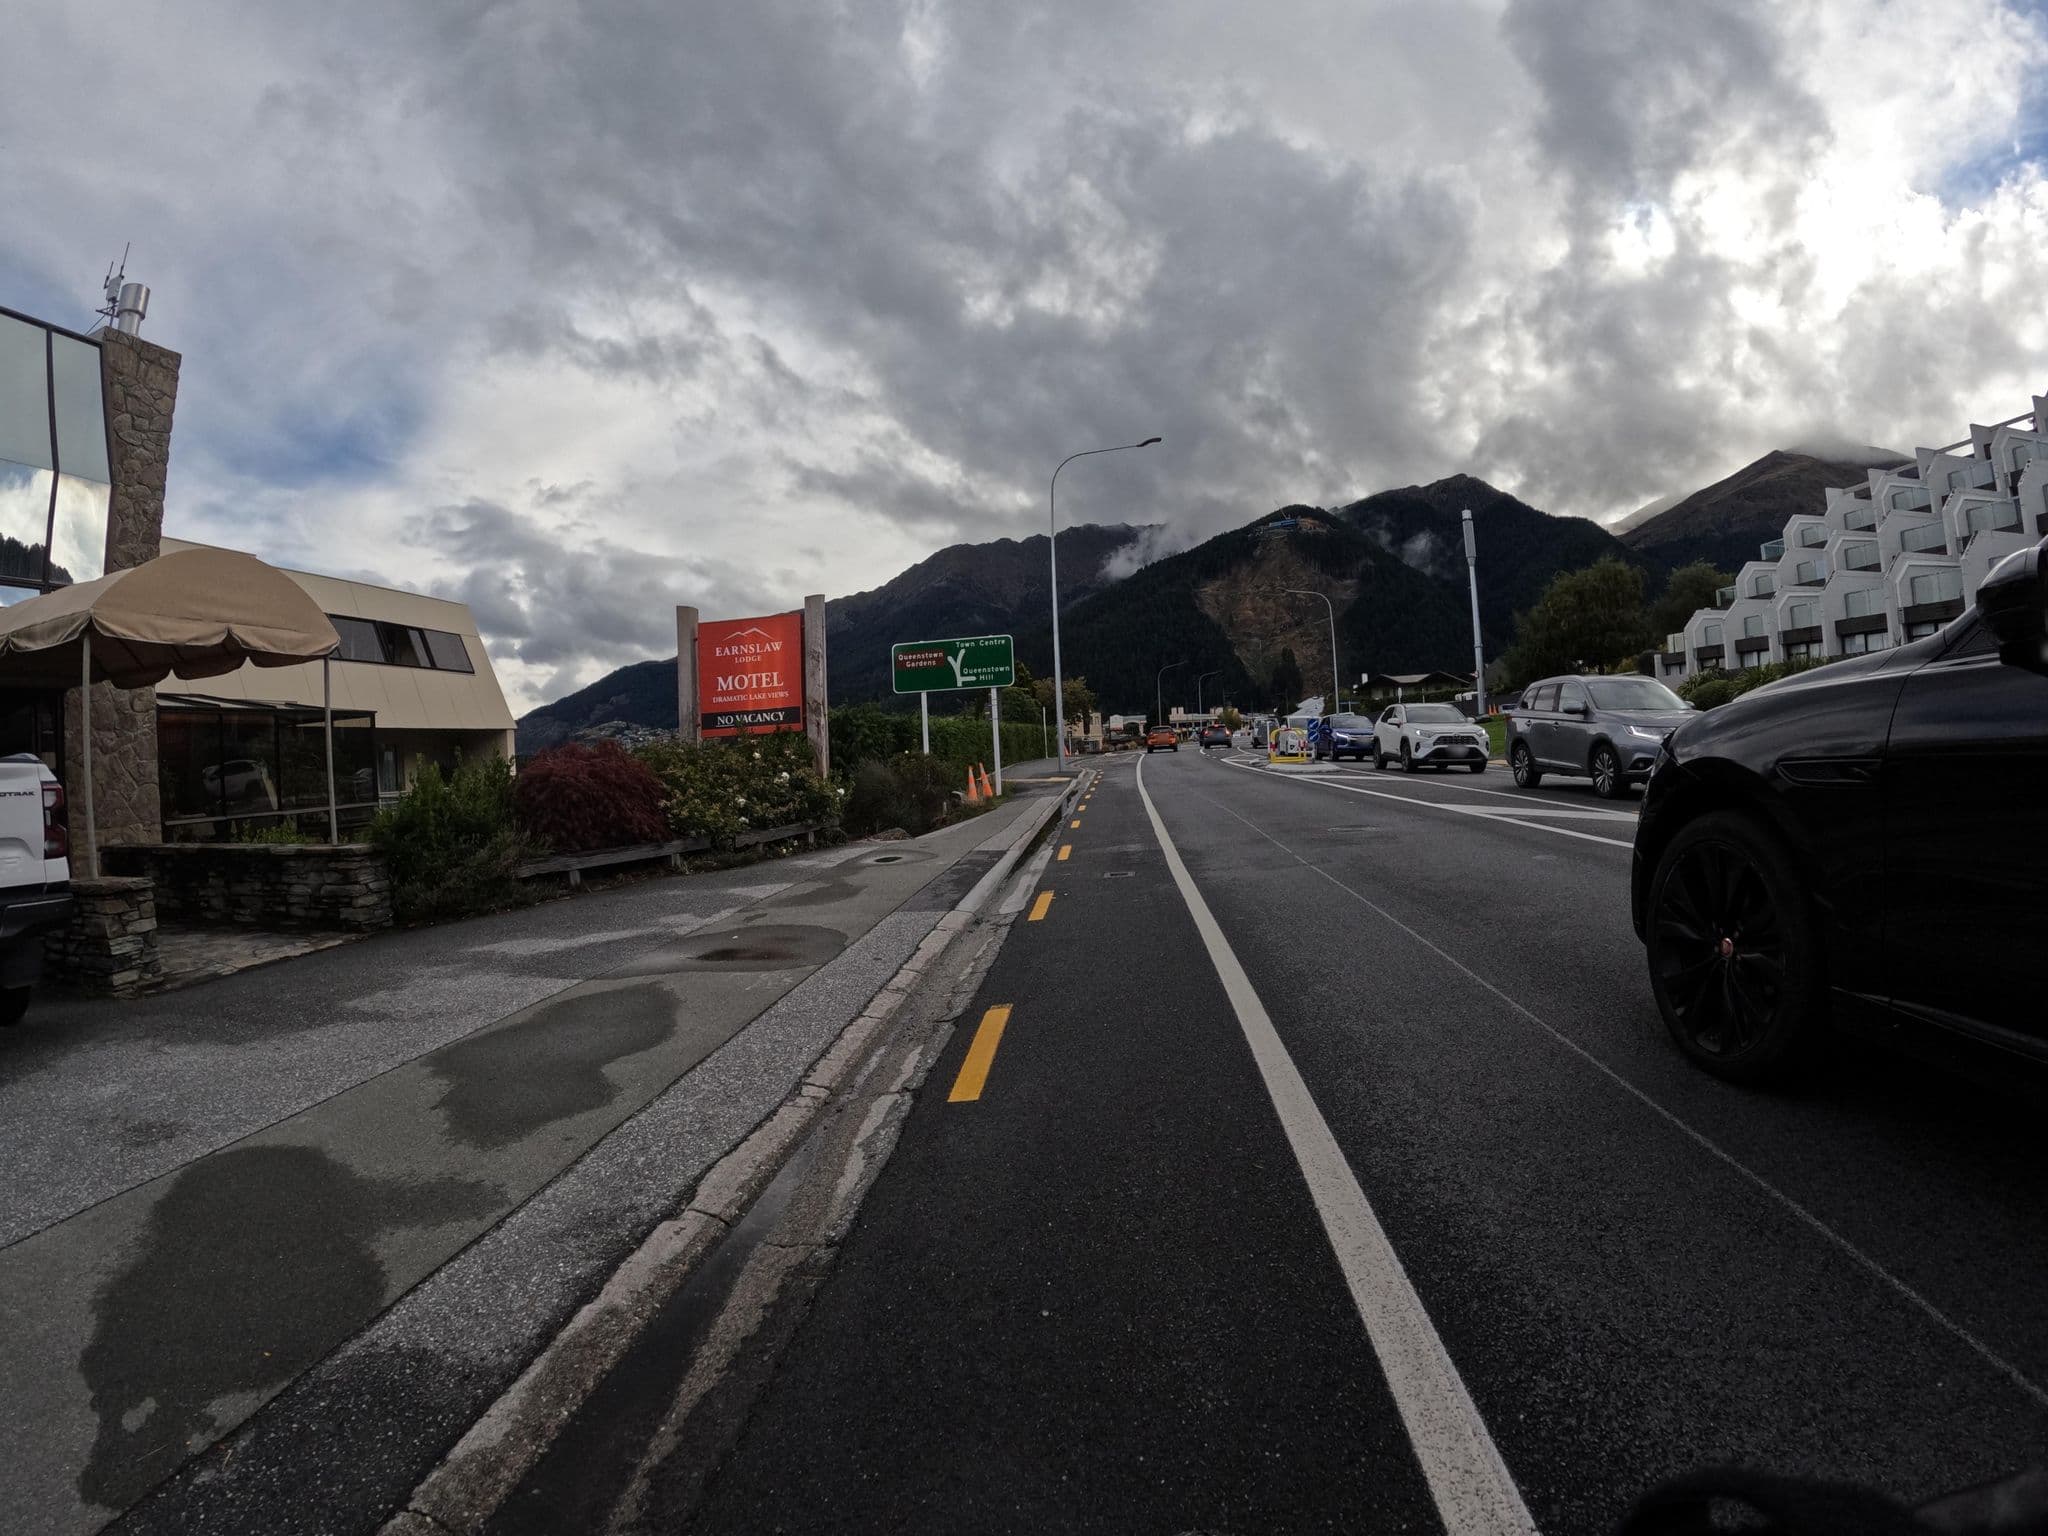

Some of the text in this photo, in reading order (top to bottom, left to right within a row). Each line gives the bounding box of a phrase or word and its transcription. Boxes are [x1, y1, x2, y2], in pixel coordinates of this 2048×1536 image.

[979, 639, 1006, 647] Centre
[715, 641, 783, 657] EARNSLAW
[735, 655, 762, 664] LODGE
[898, 652, 944, 661] Queenstown
[906, 660, 937, 668] Gardens
[962, 666, 1010, 675] Queenstown
[716, 671, 784, 692] MOTEL
[712, 690, 789, 704] DRAMATIC LAKE VIEWS
[717, 711, 785, 726] NO VACANCY
